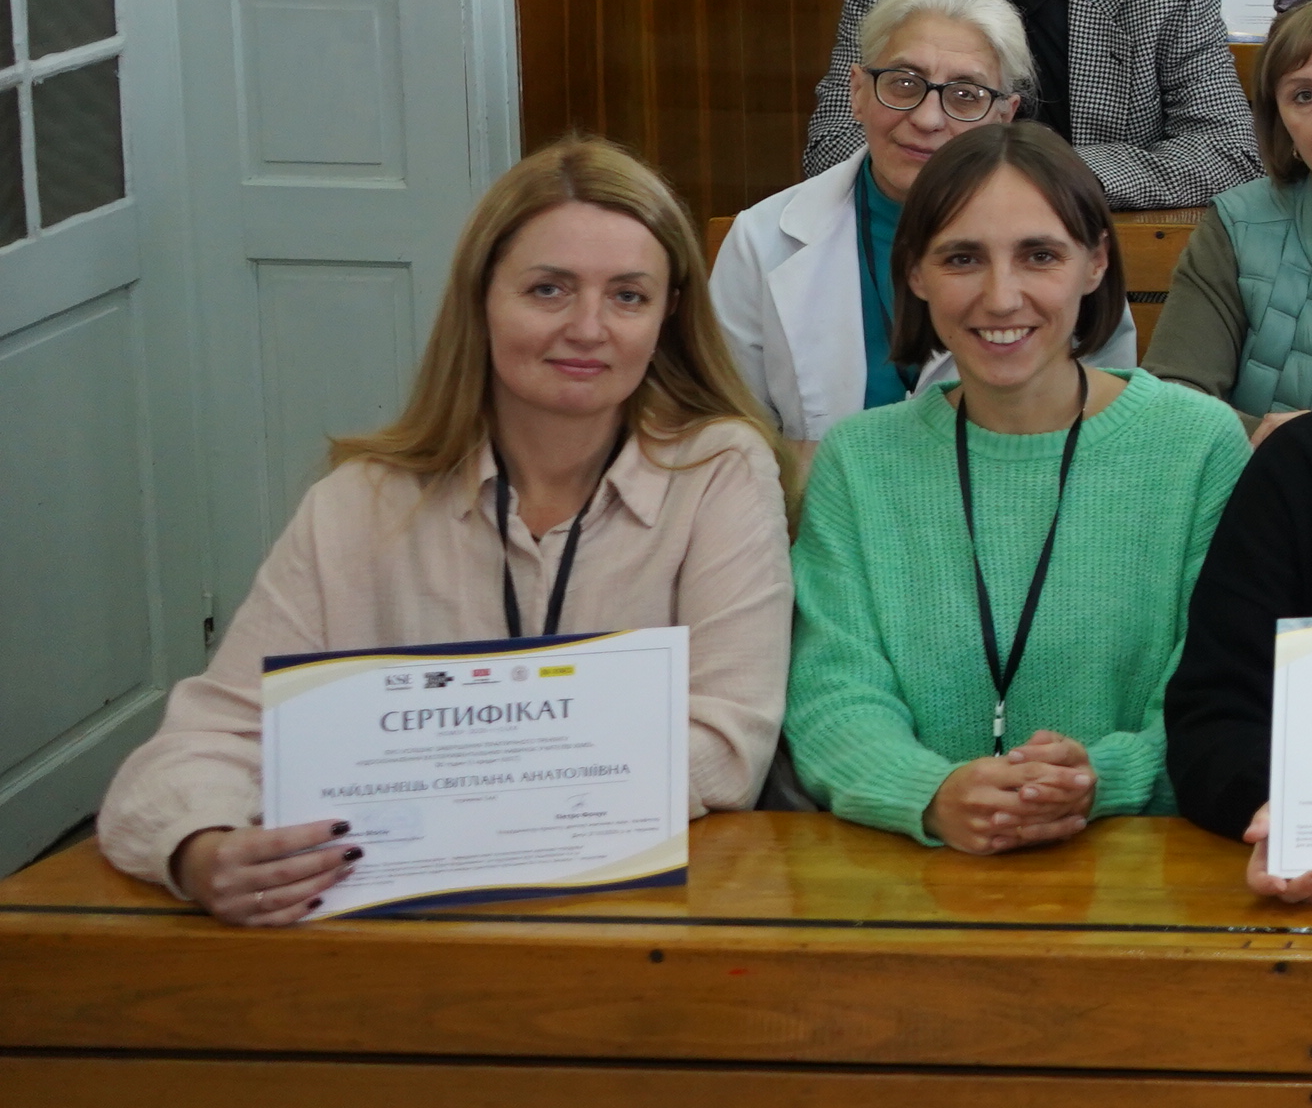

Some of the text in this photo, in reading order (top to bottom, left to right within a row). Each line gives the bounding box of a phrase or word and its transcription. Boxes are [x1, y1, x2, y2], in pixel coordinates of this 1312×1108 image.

[384, 674, 413, 687] KSE
[380, 698, 575, 733] СЕРТИФІКАТ
[432, 772, 515, 792] СВІТЛАНА
[521, 763, 630, 784] АНАТОЛІЇВНА
